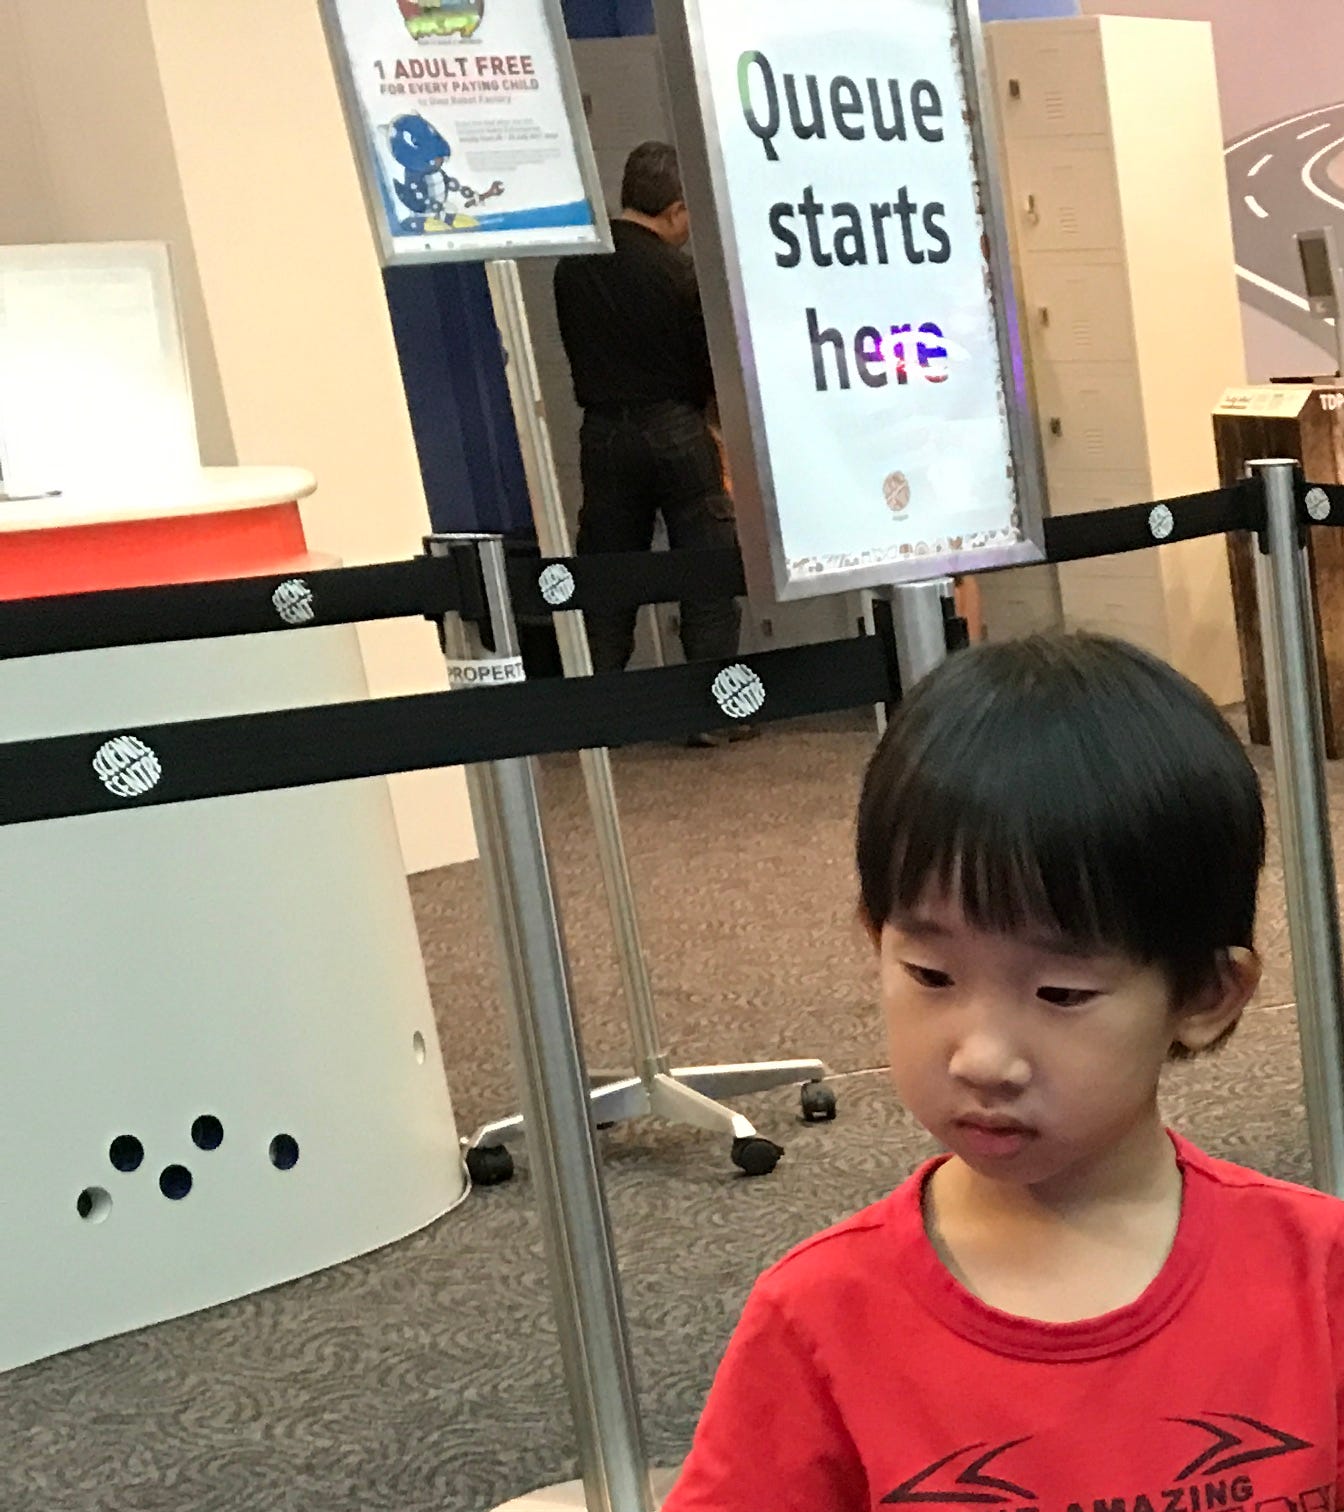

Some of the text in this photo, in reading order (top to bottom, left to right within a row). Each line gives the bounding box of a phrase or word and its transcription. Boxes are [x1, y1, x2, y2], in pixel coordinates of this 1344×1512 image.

[374, 55, 535, 79] 1 ADULT FREE
[380, 78, 539, 95] FOR EVERY PAYING CHILD
[736, 50, 944, 160] Queue
[768, 186, 951, 269] starts
[805, 308, 950, 392] here
